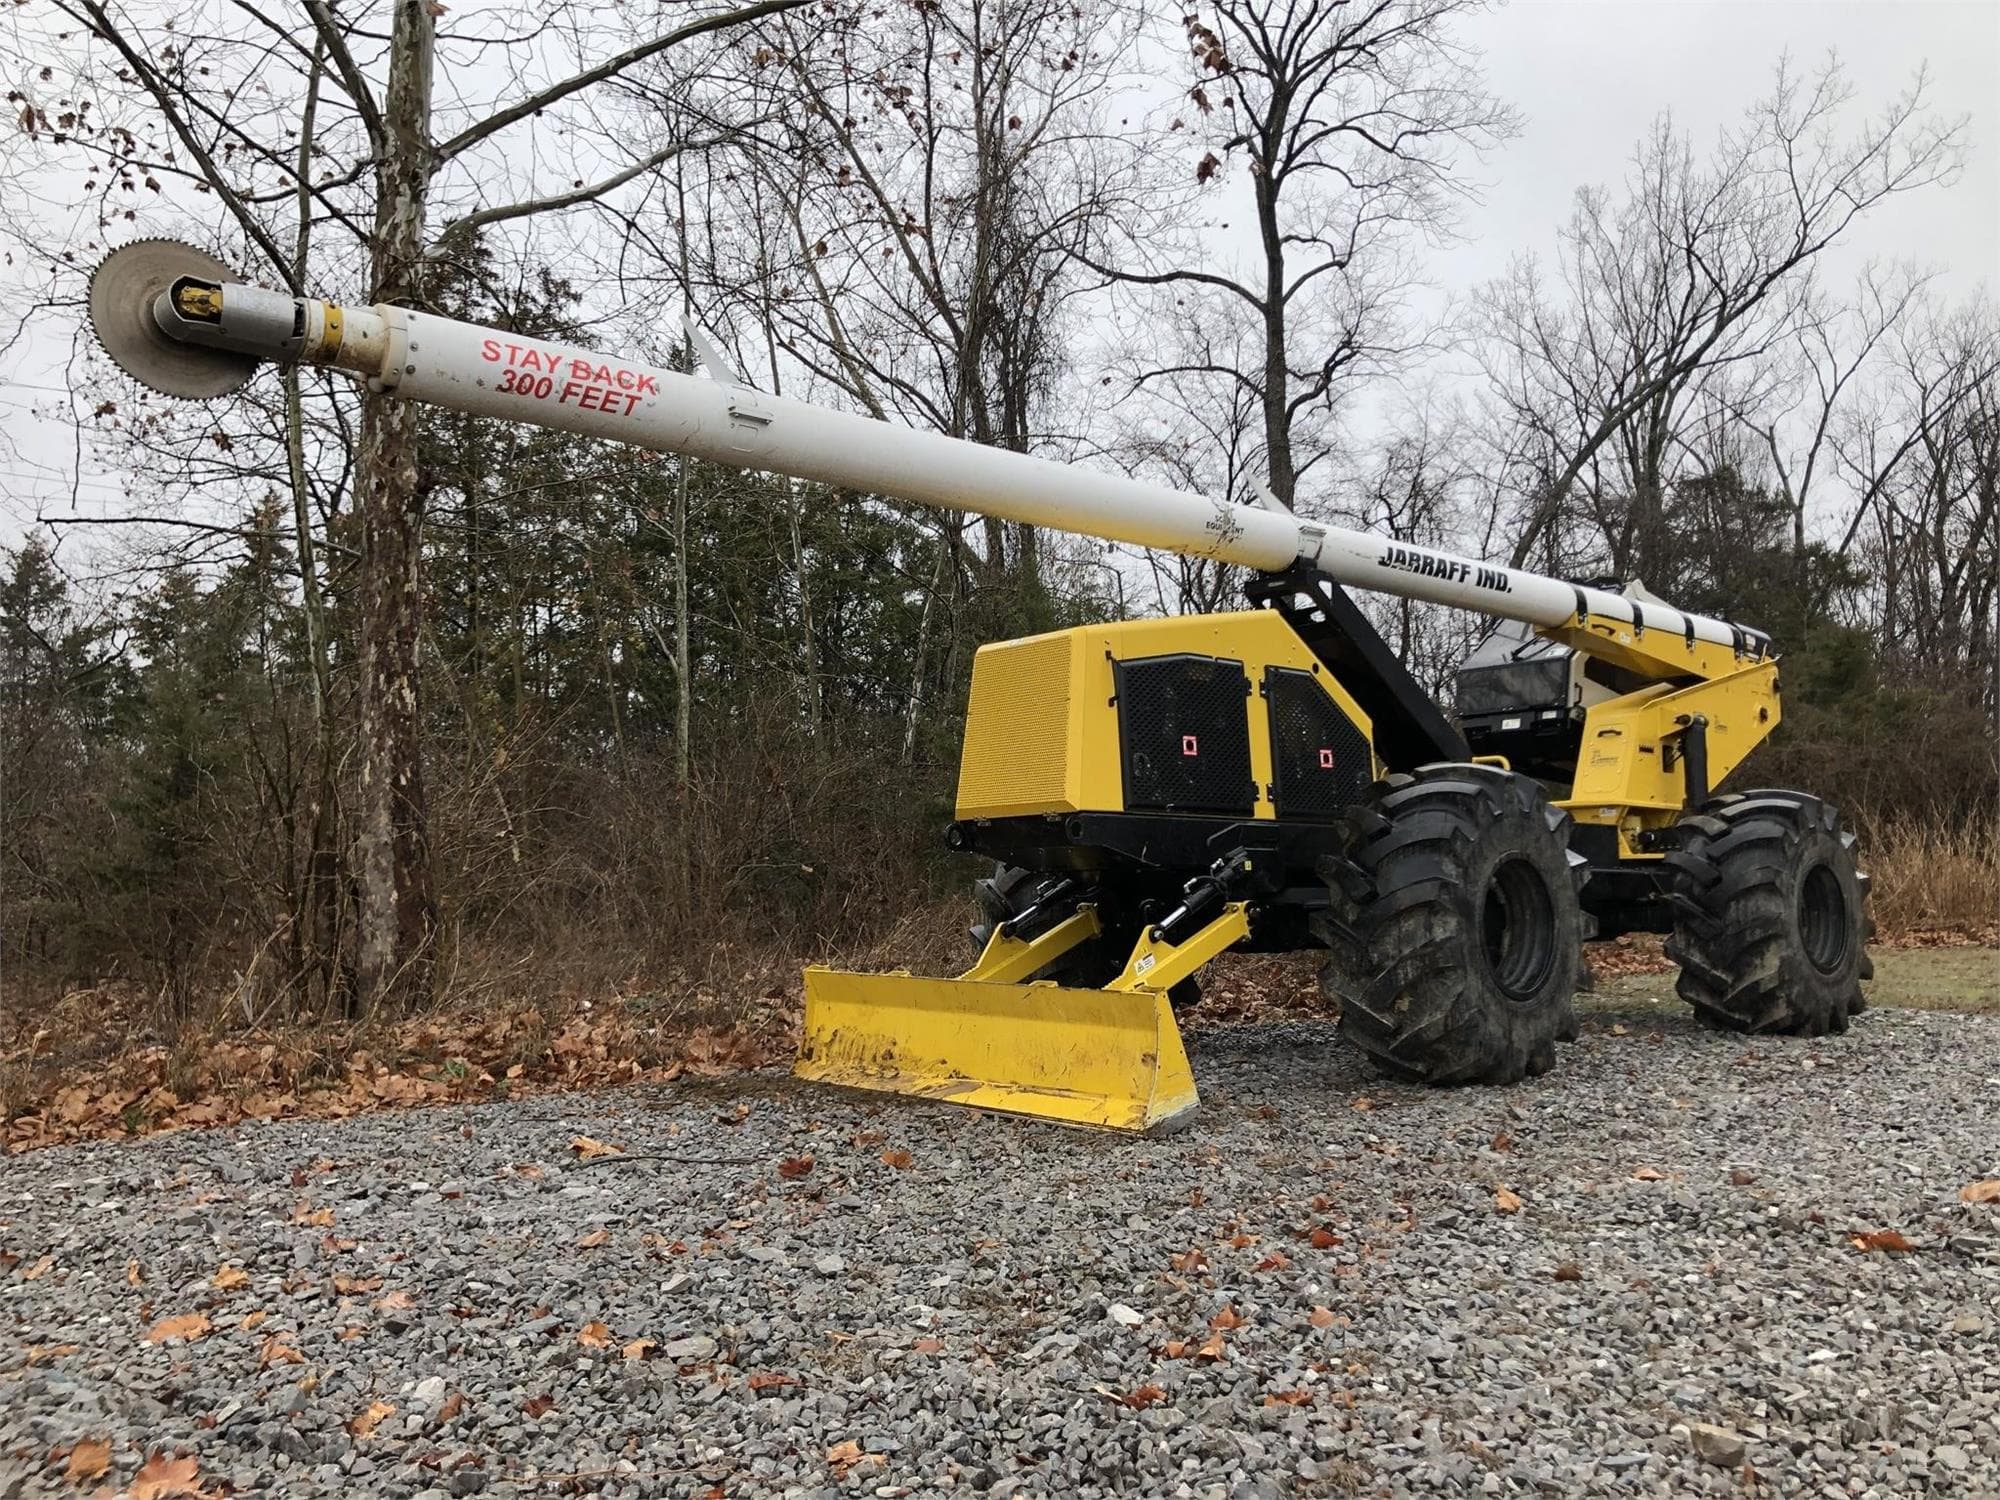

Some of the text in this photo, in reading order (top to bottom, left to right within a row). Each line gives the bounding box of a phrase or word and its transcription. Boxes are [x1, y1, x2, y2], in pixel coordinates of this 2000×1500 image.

[481, 339, 658, 396] STAY BACK
[497, 369, 643, 417] 300 FEET
[1475, 567, 1512, 594] IND.
